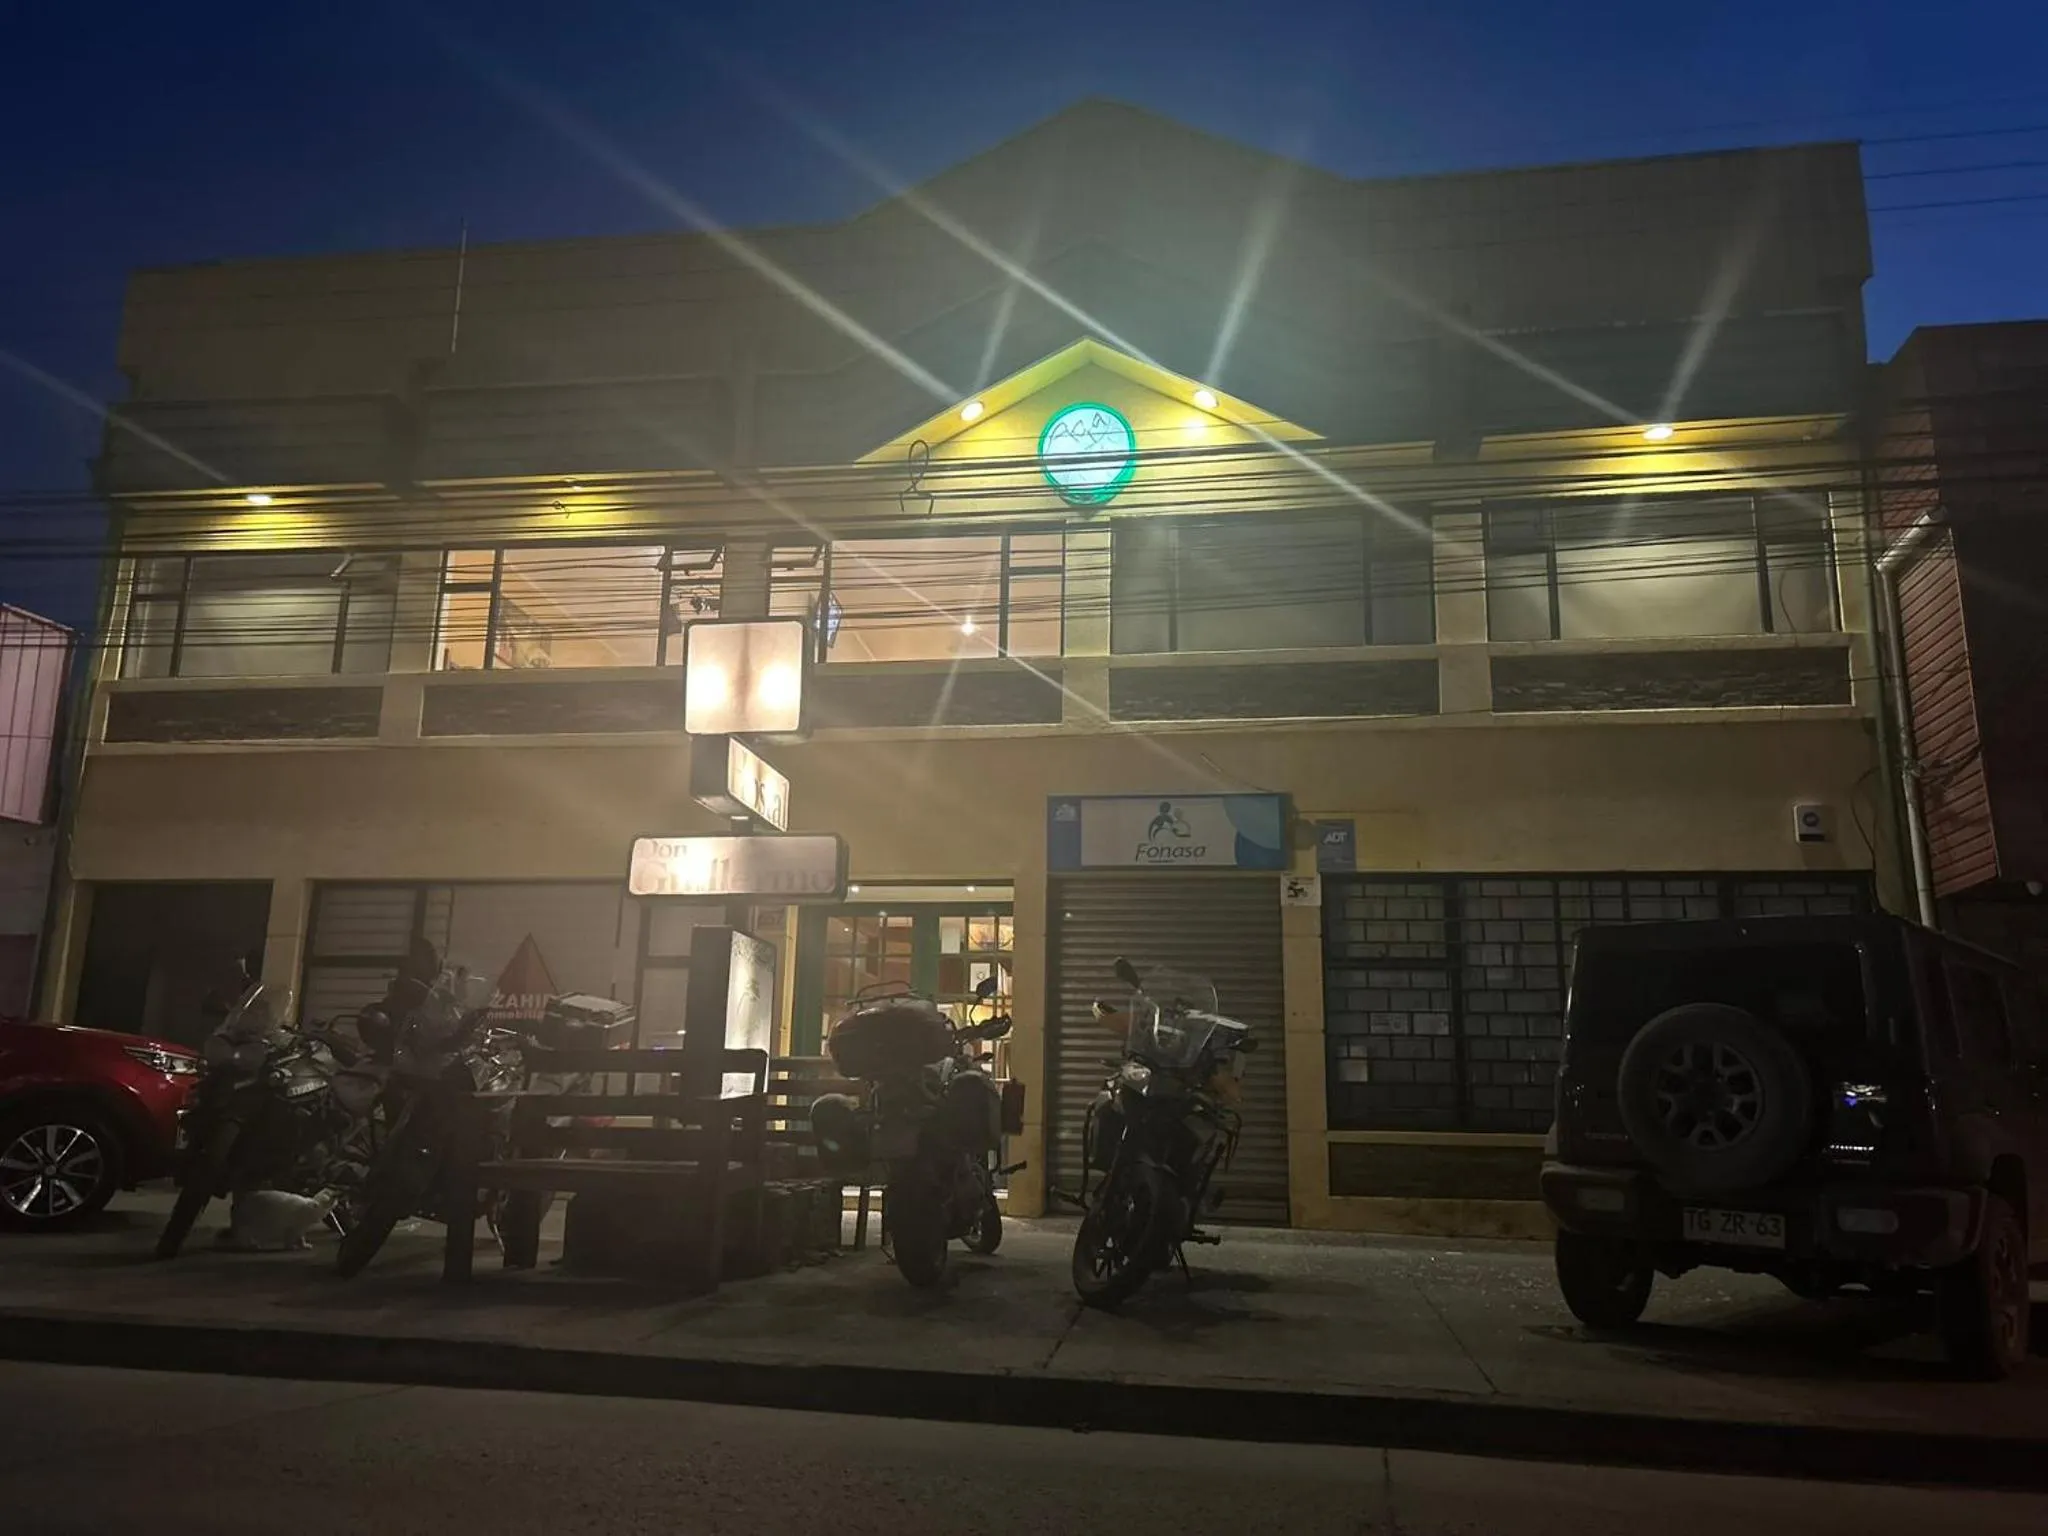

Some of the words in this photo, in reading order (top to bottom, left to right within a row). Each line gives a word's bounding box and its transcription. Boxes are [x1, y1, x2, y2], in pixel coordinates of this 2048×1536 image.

[731, 742, 787, 831] Hosal
[1322, 831, 1348, 844] ADT
[1136, 843, 1206, 862] Fonasa
[636, 858, 835, 892] Gullermo
